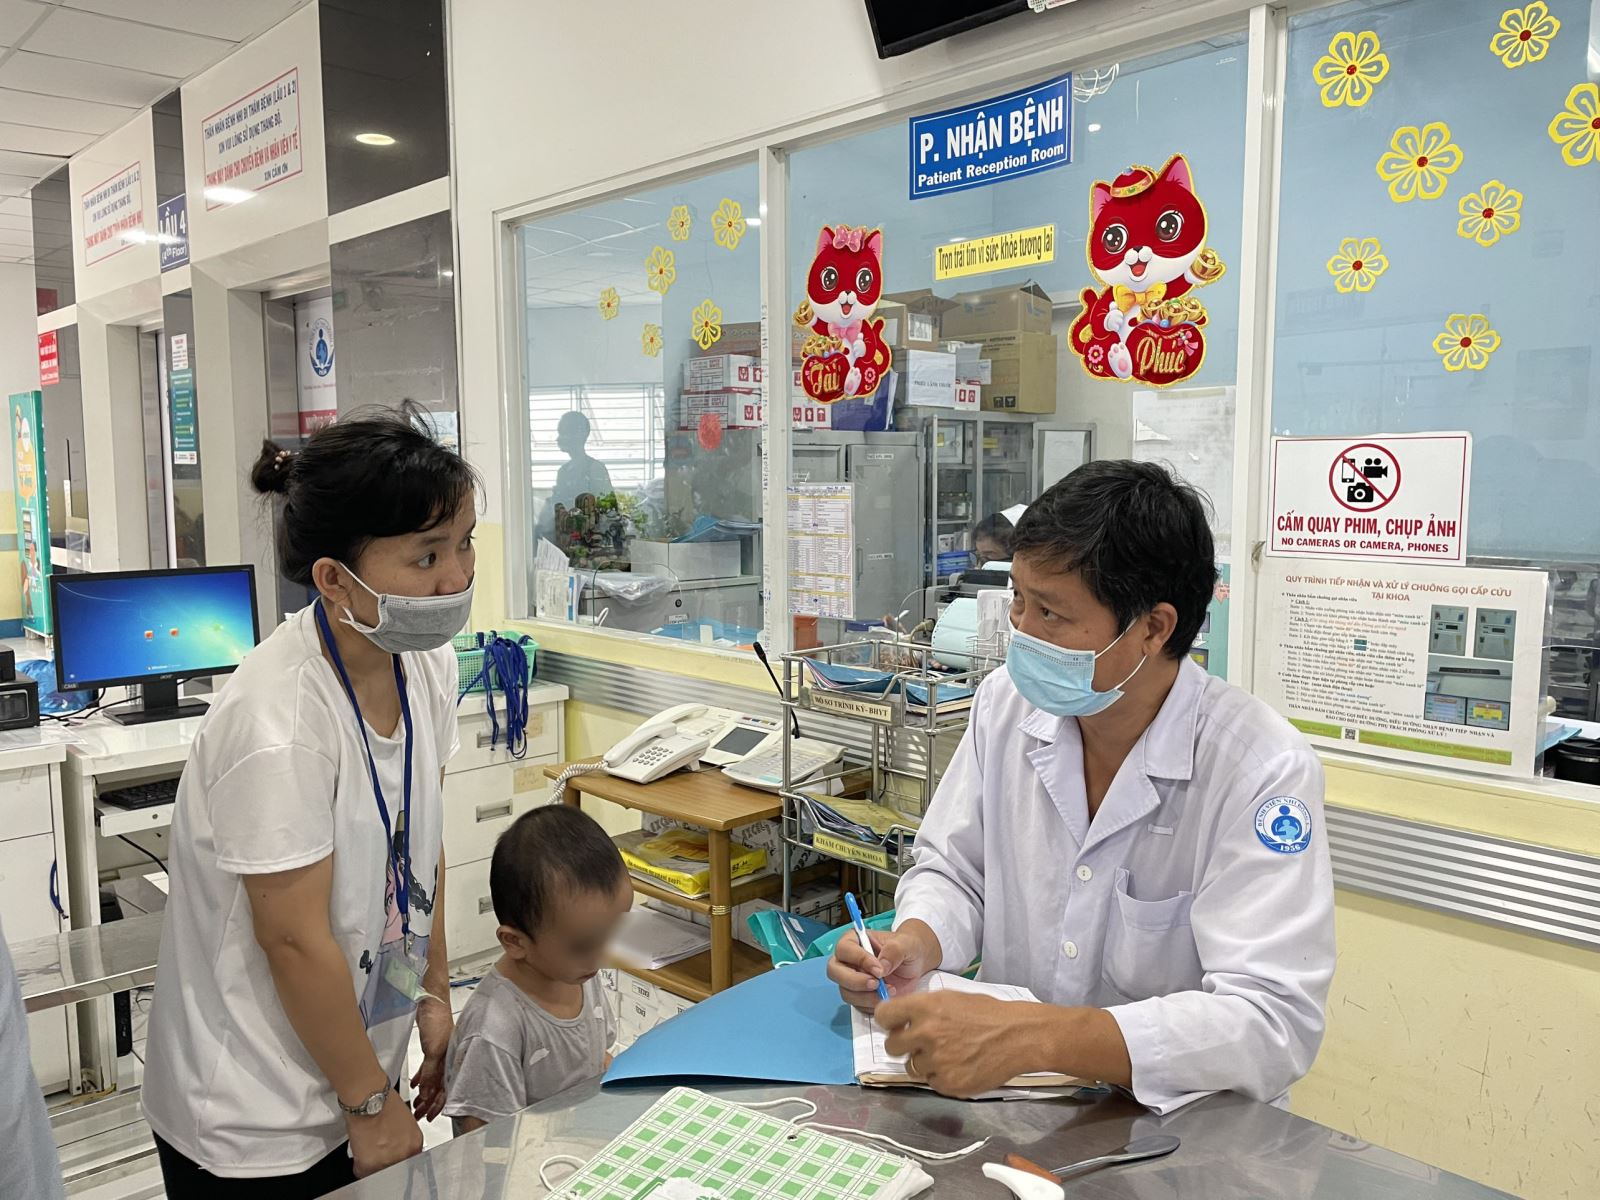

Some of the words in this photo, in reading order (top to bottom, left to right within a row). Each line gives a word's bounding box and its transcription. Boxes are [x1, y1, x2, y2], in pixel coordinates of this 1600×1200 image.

[921, 133, 939, 164] P.
[947, 112, 1002, 159] NHẬN
[1010, 97, 1063, 146] BỆNH
[919, 168, 962, 187] Patient
[966, 154, 1027, 177] Reception
[1031, 144, 1064, 162] Room
[180, 210, 185, 233] 4
[172, 243, 186, 258] Floor)
[939, 248, 952, 276] Trọn
[954, 244, 964, 268] trái
[967, 243, 976, 266] tim
[978, 240, 984, 263] vì
[986, 238, 998, 262] sức
[1001, 234, 1017, 260] khỏe
[1020, 235, 1041, 260] tương
[1044, 227, 1052, 252] lai
[1136, 336, 1185, 375] Phúc
[810, 362, 840, 395] Tài
[1278, 510, 1303, 532] CẤM
[1308, 517, 1340, 535] QUAY
[1344, 518, 1381, 537] PHIM,
[1386, 519, 1423, 539] CHỤP
[1427, 514, 1456, 537] ẢNH
[1297, 538, 1340, 548] CAMERAS
[1344, 540, 1356, 548] OR
[1360, 541, 1403, 552] CAMERA,
[1408, 543, 1448, 552] PHONES
[1286, 575, 1302, 583] QUY
[1304, 576, 1327, 584] TRÌNH
[1329, 576, 1345, 586] TIẾP
[1346, 578, 1370, 588] NHẬN
[1372, 579, 1384, 588] VÀ
[1386, 580, 1398, 590] XỬ
[1400, 582, 1409, 590] LÝ
[1411, 582, 1449, 593] CHUÔNG
[1452, 586, 1468, 595] GỌI
[1470, 585, 1488, 595] CẤP
[1491, 587, 1512, 597] CỨU
[1371, 592, 1384, 600] TẠI
[1280, 844, 1300, 852] 1956
